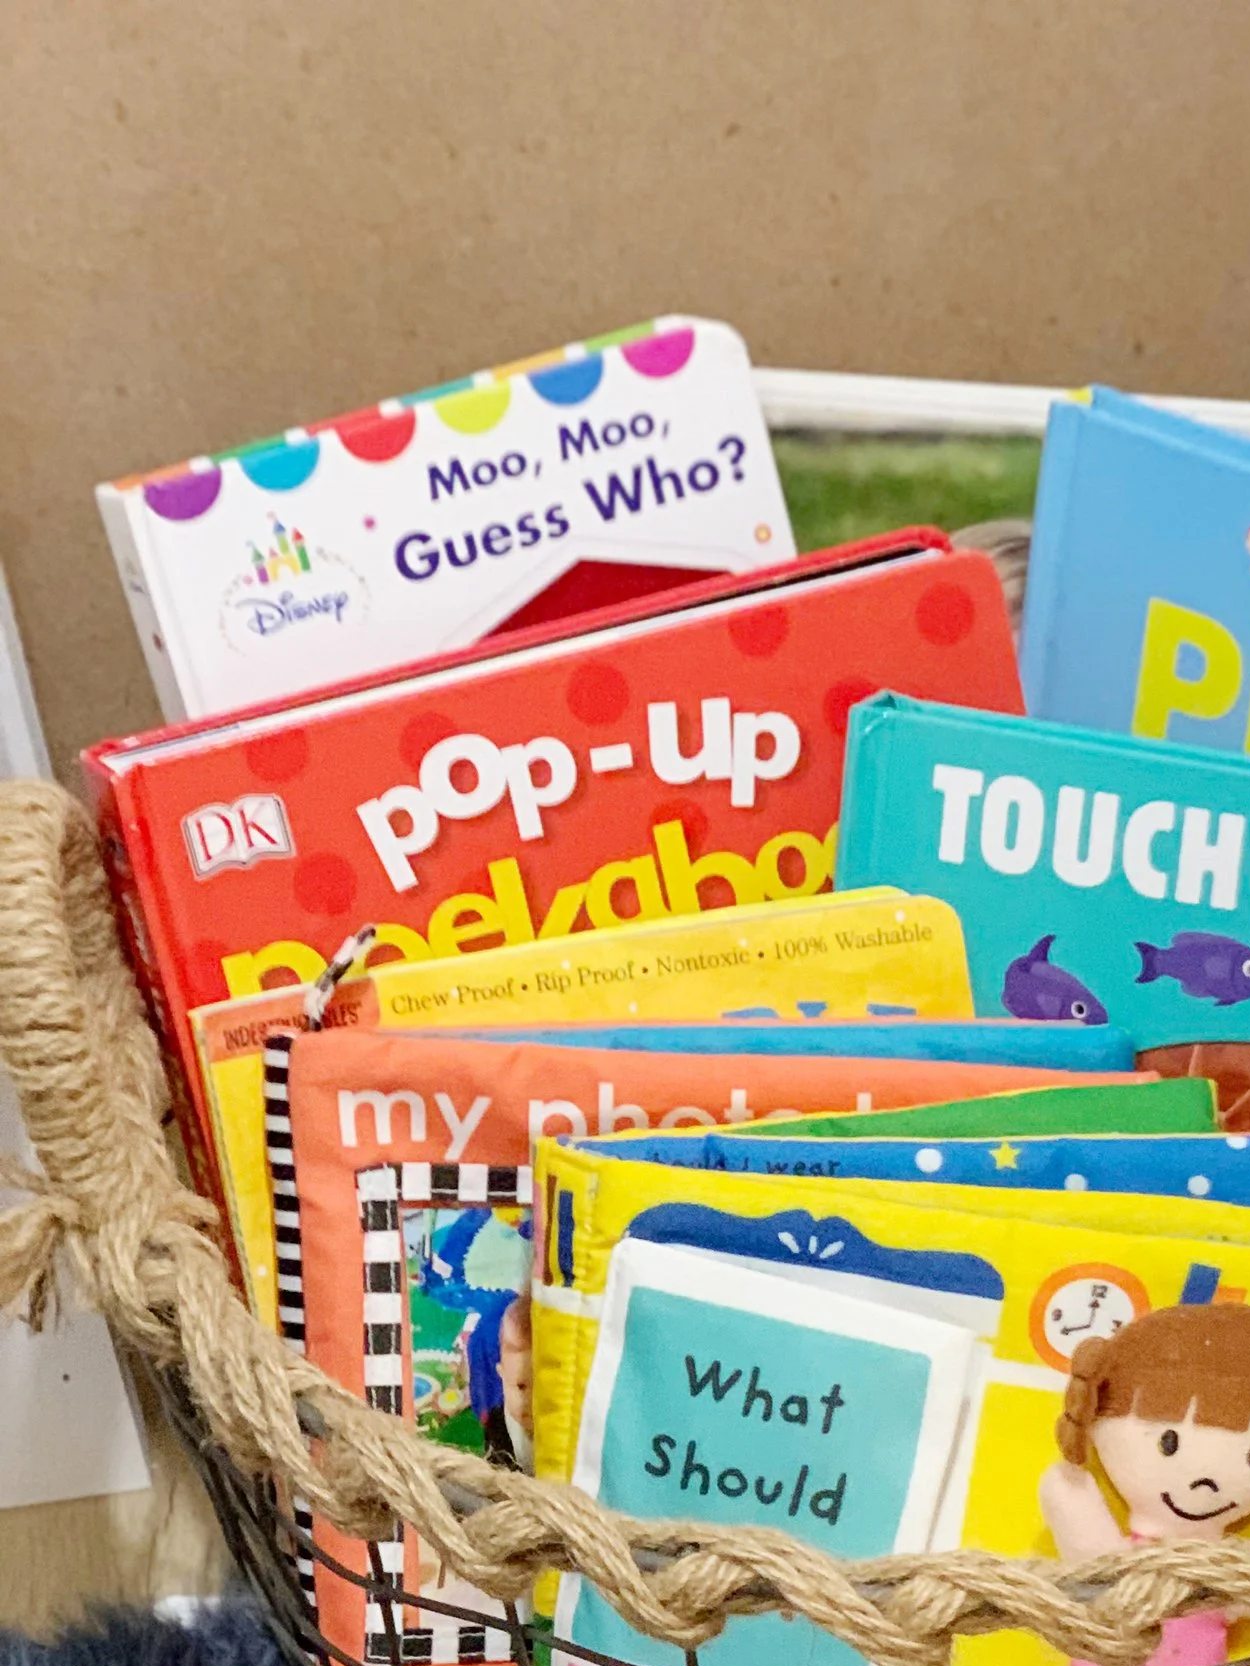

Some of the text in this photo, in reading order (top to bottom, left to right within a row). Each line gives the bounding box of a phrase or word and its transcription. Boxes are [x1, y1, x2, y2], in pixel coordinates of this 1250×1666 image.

[427, 413, 669, 500] Moo, Moo,
[394, 436, 746, 581] Guess Who?
[235, 591, 348, 635] Disney
[197, 805, 280, 862] DK
[932, 763, 1246, 911] TOUCH
[391, 922, 934, 1015] Chew Proof Rip Proof Nontoxic 100% Washable
[338, 1088, 491, 1161] my
[684, 1354, 845, 1434] What
